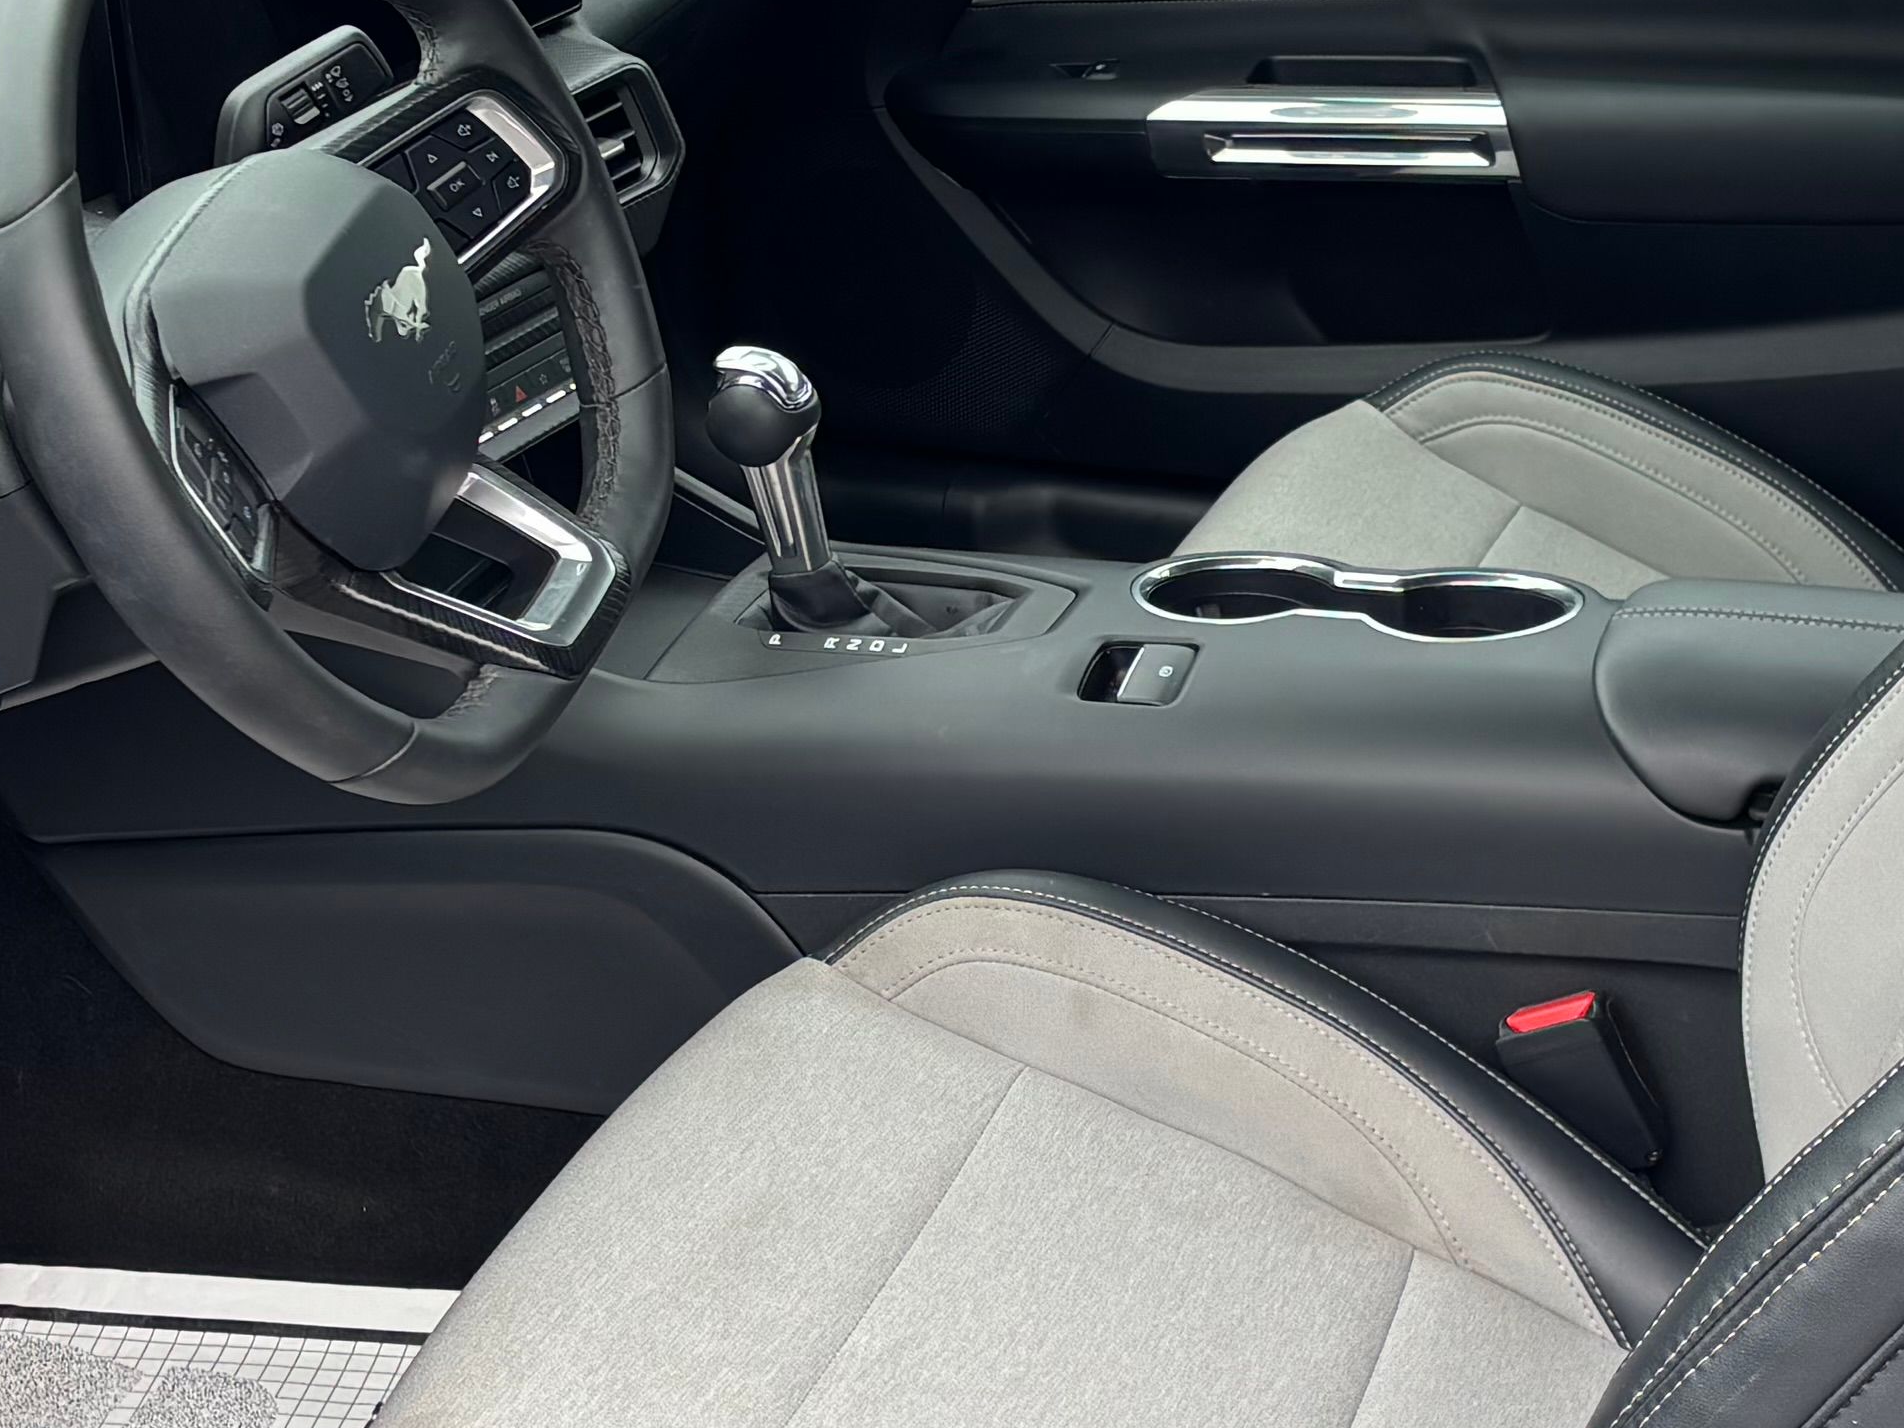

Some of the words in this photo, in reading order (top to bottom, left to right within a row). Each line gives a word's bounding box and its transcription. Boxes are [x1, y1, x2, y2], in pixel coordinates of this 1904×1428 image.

[449, 177, 466, 193] OK
[768, 633, 782, 645] P
[823, 637, 840, 649] R
